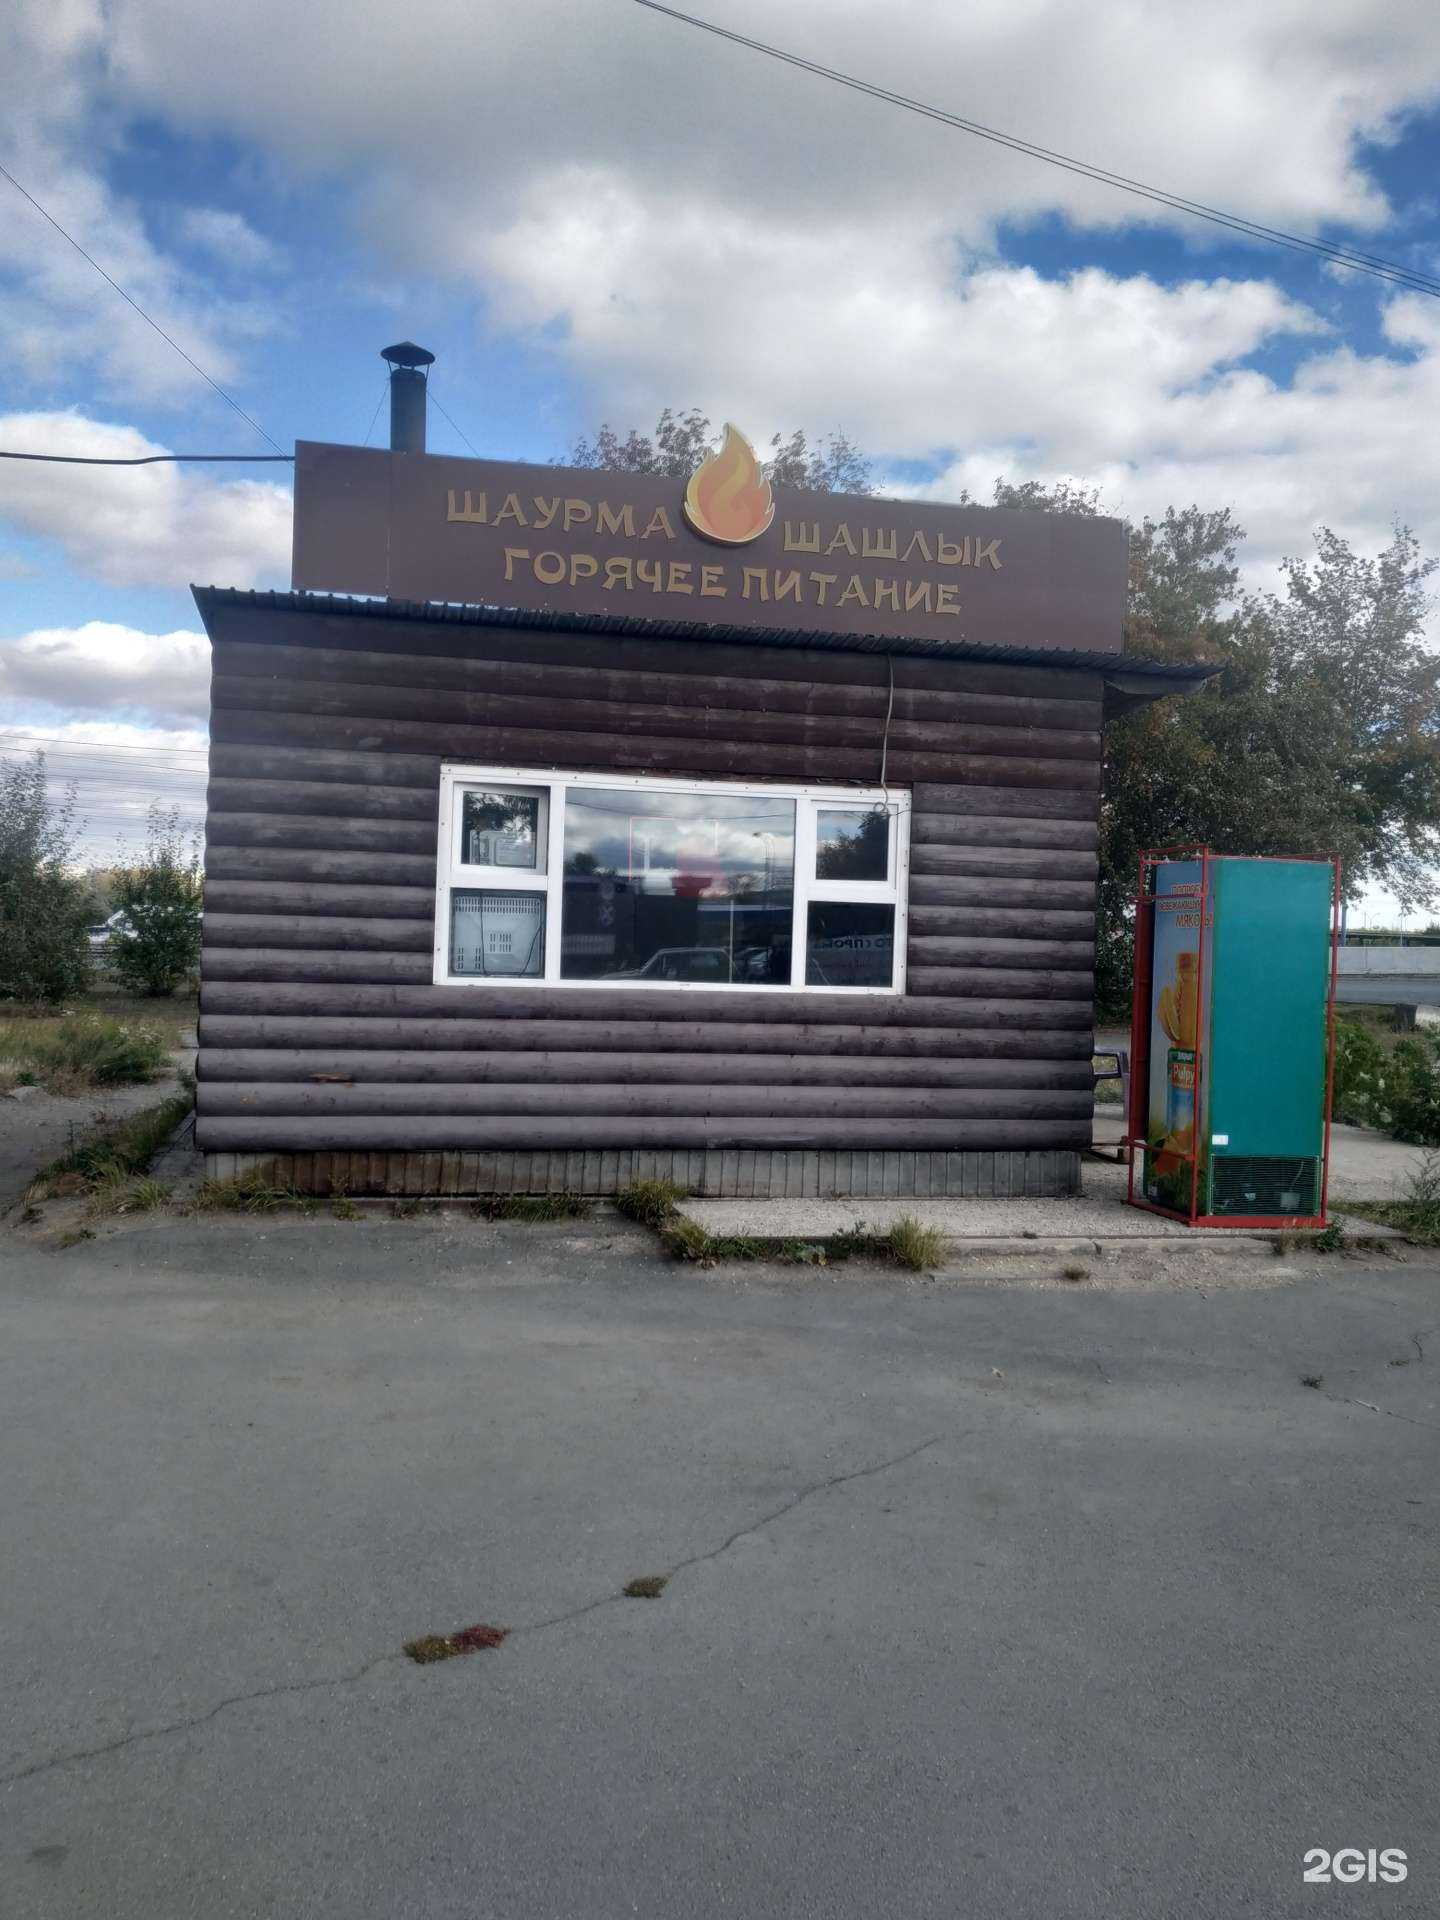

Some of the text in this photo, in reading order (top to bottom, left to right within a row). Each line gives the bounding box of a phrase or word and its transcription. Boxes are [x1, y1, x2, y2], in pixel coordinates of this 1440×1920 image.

[447, 489, 1003, 570] ШАУРМА ШАШЛЫК
[504, 547, 962, 615] ГОРЯЧЕЕ ПИТАНИЕ
